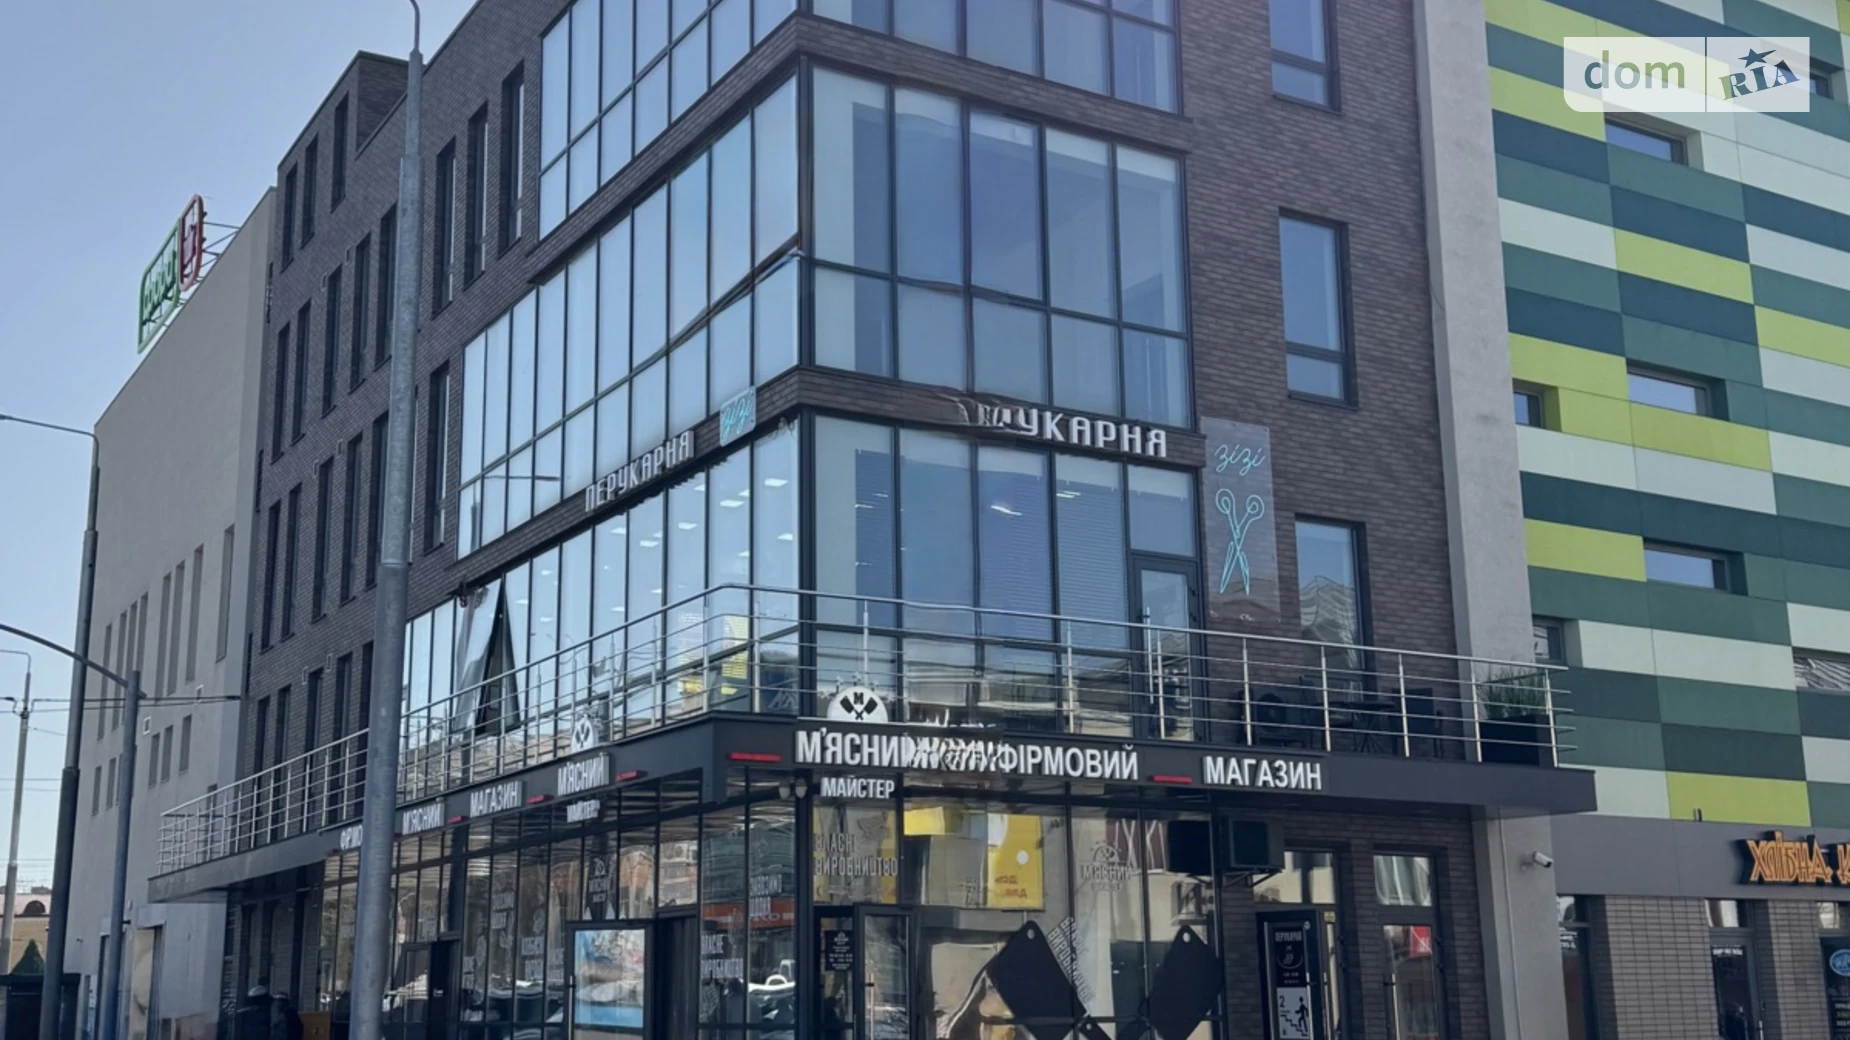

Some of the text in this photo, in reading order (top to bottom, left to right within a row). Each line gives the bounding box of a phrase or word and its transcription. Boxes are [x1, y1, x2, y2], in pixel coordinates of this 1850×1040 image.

[585, 430, 693, 513] ПЕРУКАРНЯ
[558, 752, 610, 796] М'ЯСНИЙ
[999, 740, 1139, 781] ФІРМОВИЙ
[1203, 755, 1323, 791] МАГАЗИН
[470, 779, 523, 818] МАГАЗИН
[820, 774, 896, 799] МАЙСТЕР
[815, 856, 899, 877] ВИРОБНИЦТВО
